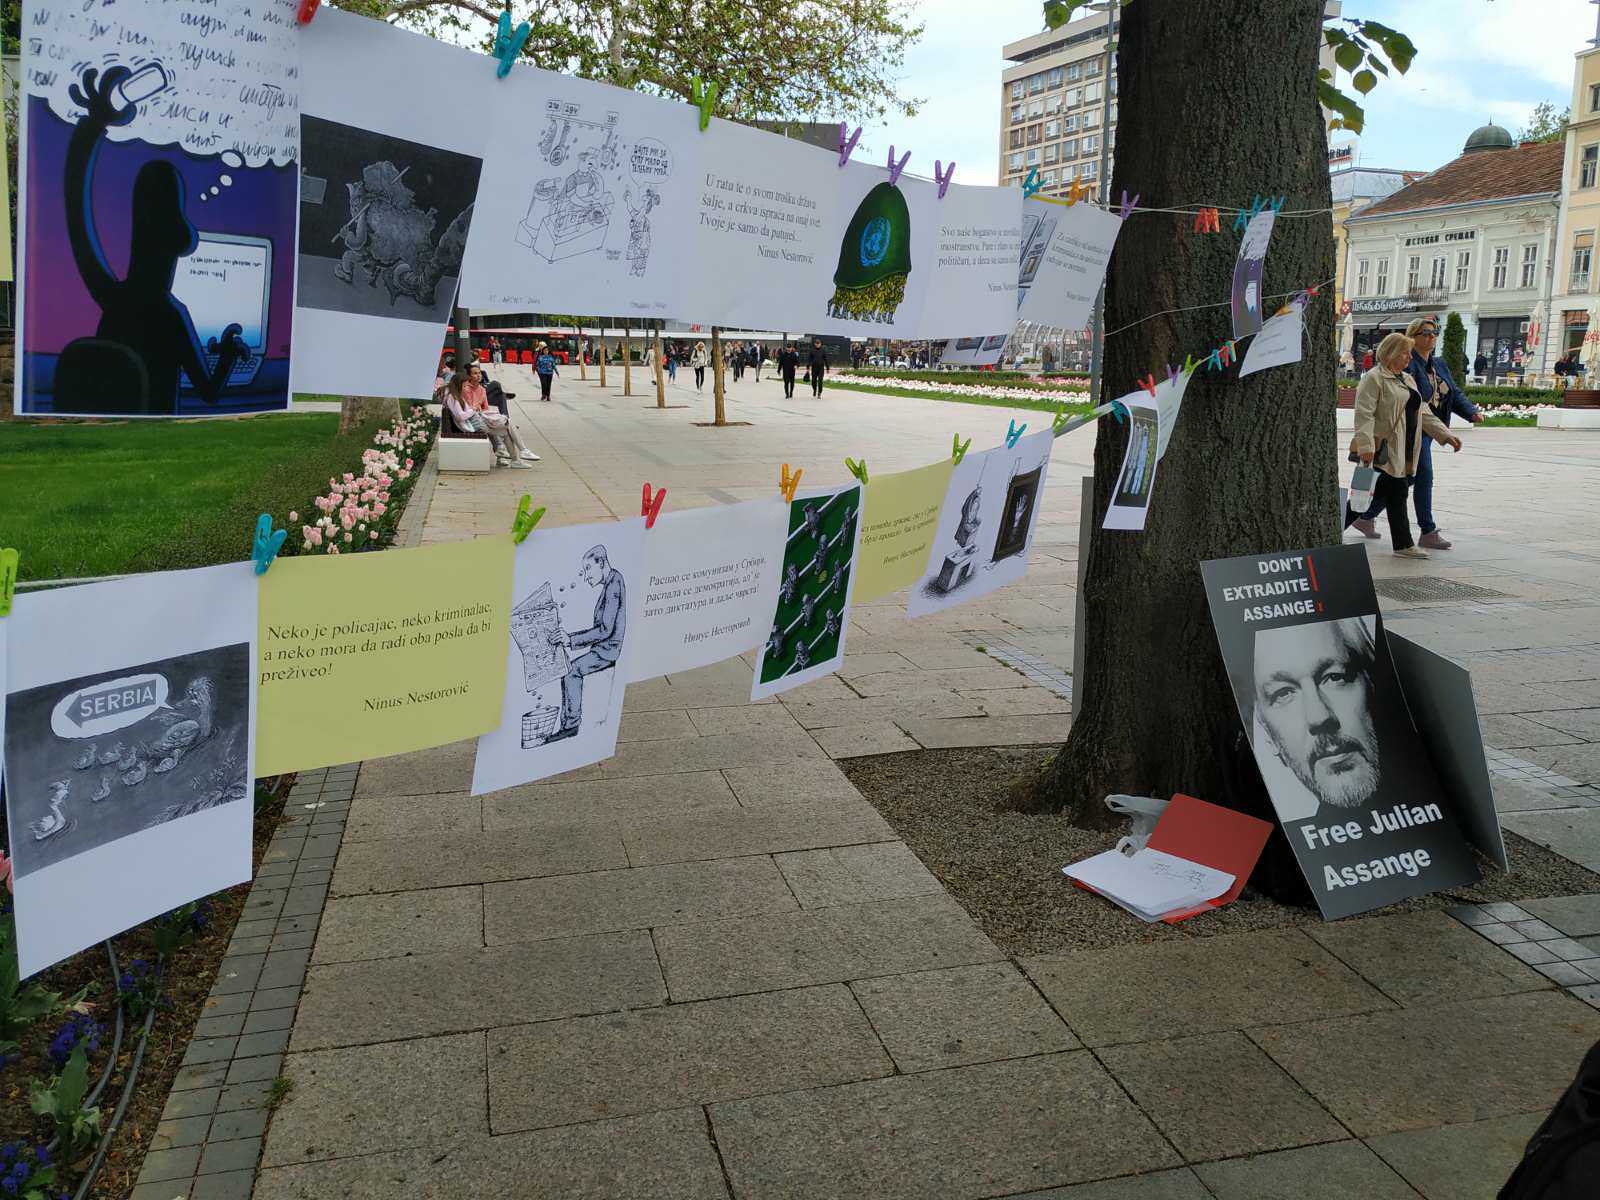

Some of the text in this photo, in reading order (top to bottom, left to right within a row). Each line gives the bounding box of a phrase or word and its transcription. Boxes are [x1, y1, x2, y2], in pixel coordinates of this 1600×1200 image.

[706, 174, 715, 187] U
[716, 179, 734, 191] ratu
[745, 186, 752, 194] o
[753, 187, 774, 199] svom
[727, 202, 733, 210] a
[735, 202, 758, 215] crkva
[700, 212, 726, 230] Tvoje
[726, 221, 735, 232] je
[737, 222, 759, 234] samo
[760, 224, 770, 237] da
[1258, 556, 1304, 574] DON'T
[649, 574, 680, 587] Распао
[681, 573, 692, 582] се
[1222, 577, 1310, 602] EXTRADITE
[646, 589, 681, 605] распала
[683, 586, 693, 596] се
[664, 598, 707, 616] диктатура
[708, 597, 714, 605] и
[267, 602, 493, 641] Neko je policajac, neko kriminalac,
[263, 651, 273, 662] a
[277, 644, 316, 661] neko
[319, 644, 357, 657] mora
[360, 639, 377, 653] da
[380, 635, 406, 651] radi
[409, 631, 431, 646] oba
[433, 625, 464, 644] posla
[466, 621, 479, 636] da
[481, 620, 492, 633] bi
[260, 663, 333, 686] preživeo!
[80, 685, 154, 718] SERBIA
[363, 681, 470, 712] Ninus Nestorović
[1300, 802, 1444, 850] Free Julian
[1322, 848, 1432, 892] Assange
